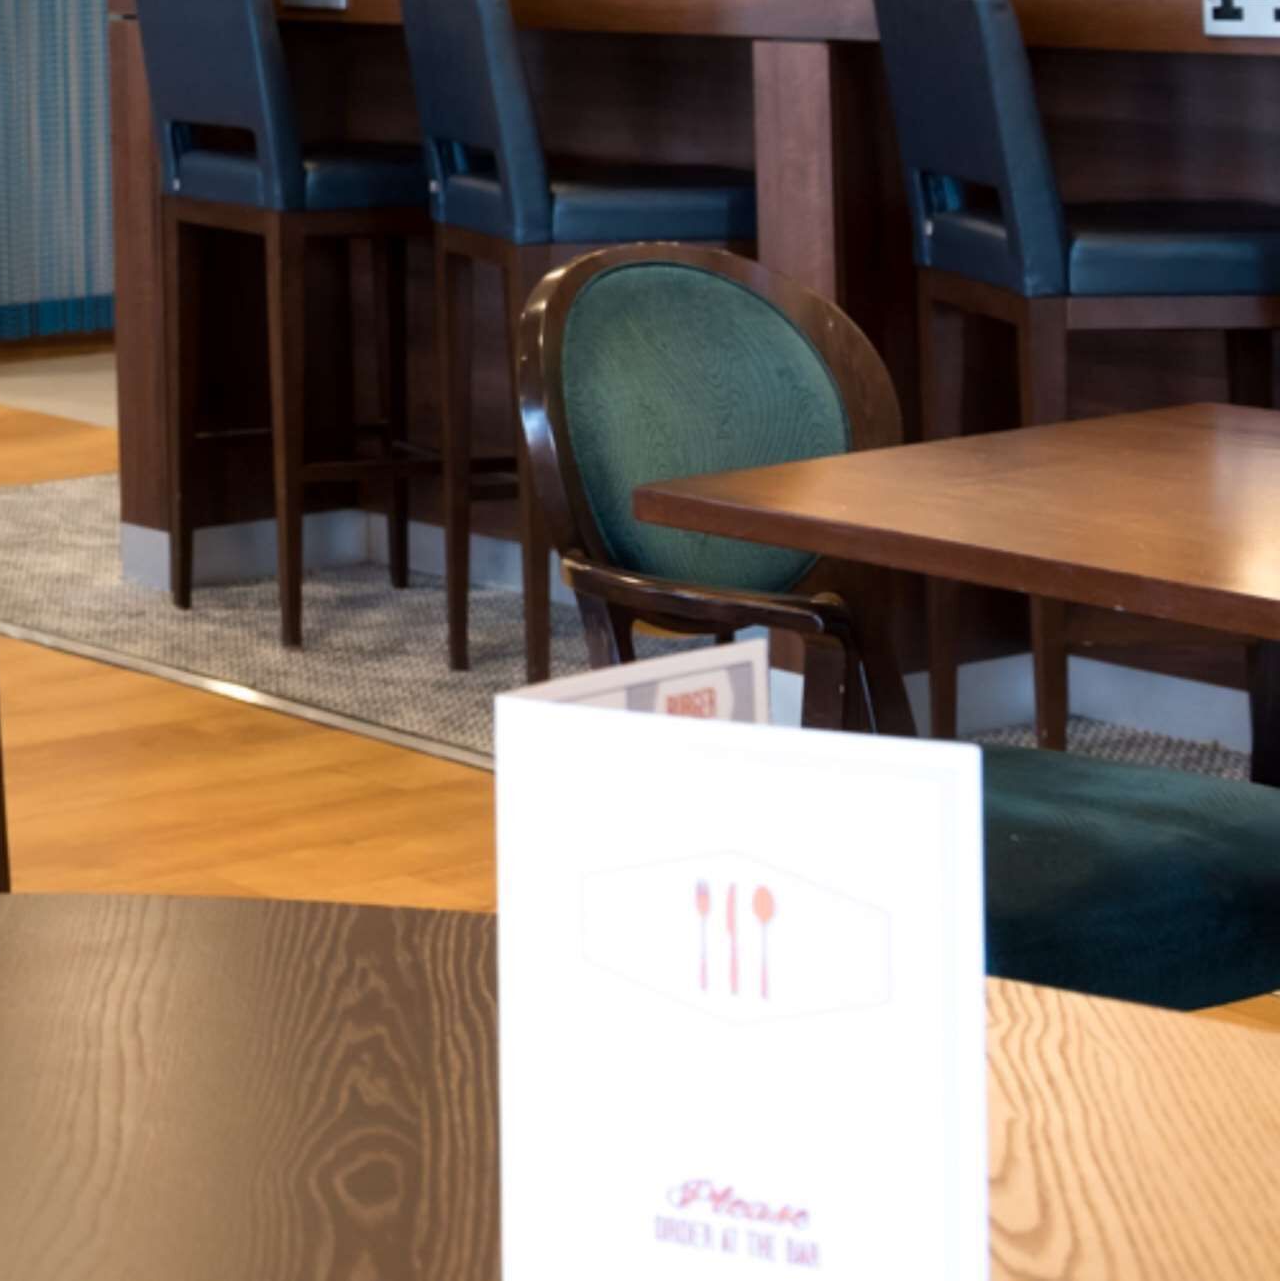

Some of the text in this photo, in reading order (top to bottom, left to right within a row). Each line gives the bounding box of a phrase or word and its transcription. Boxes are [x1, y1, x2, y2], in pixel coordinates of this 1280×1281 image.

[666, 1178, 810, 1230] Please
[654, 1214, 713, 1252] ORDER
[746, 1228, 776, 1264] THE
[786, 1235, 820, 1270] BAR
